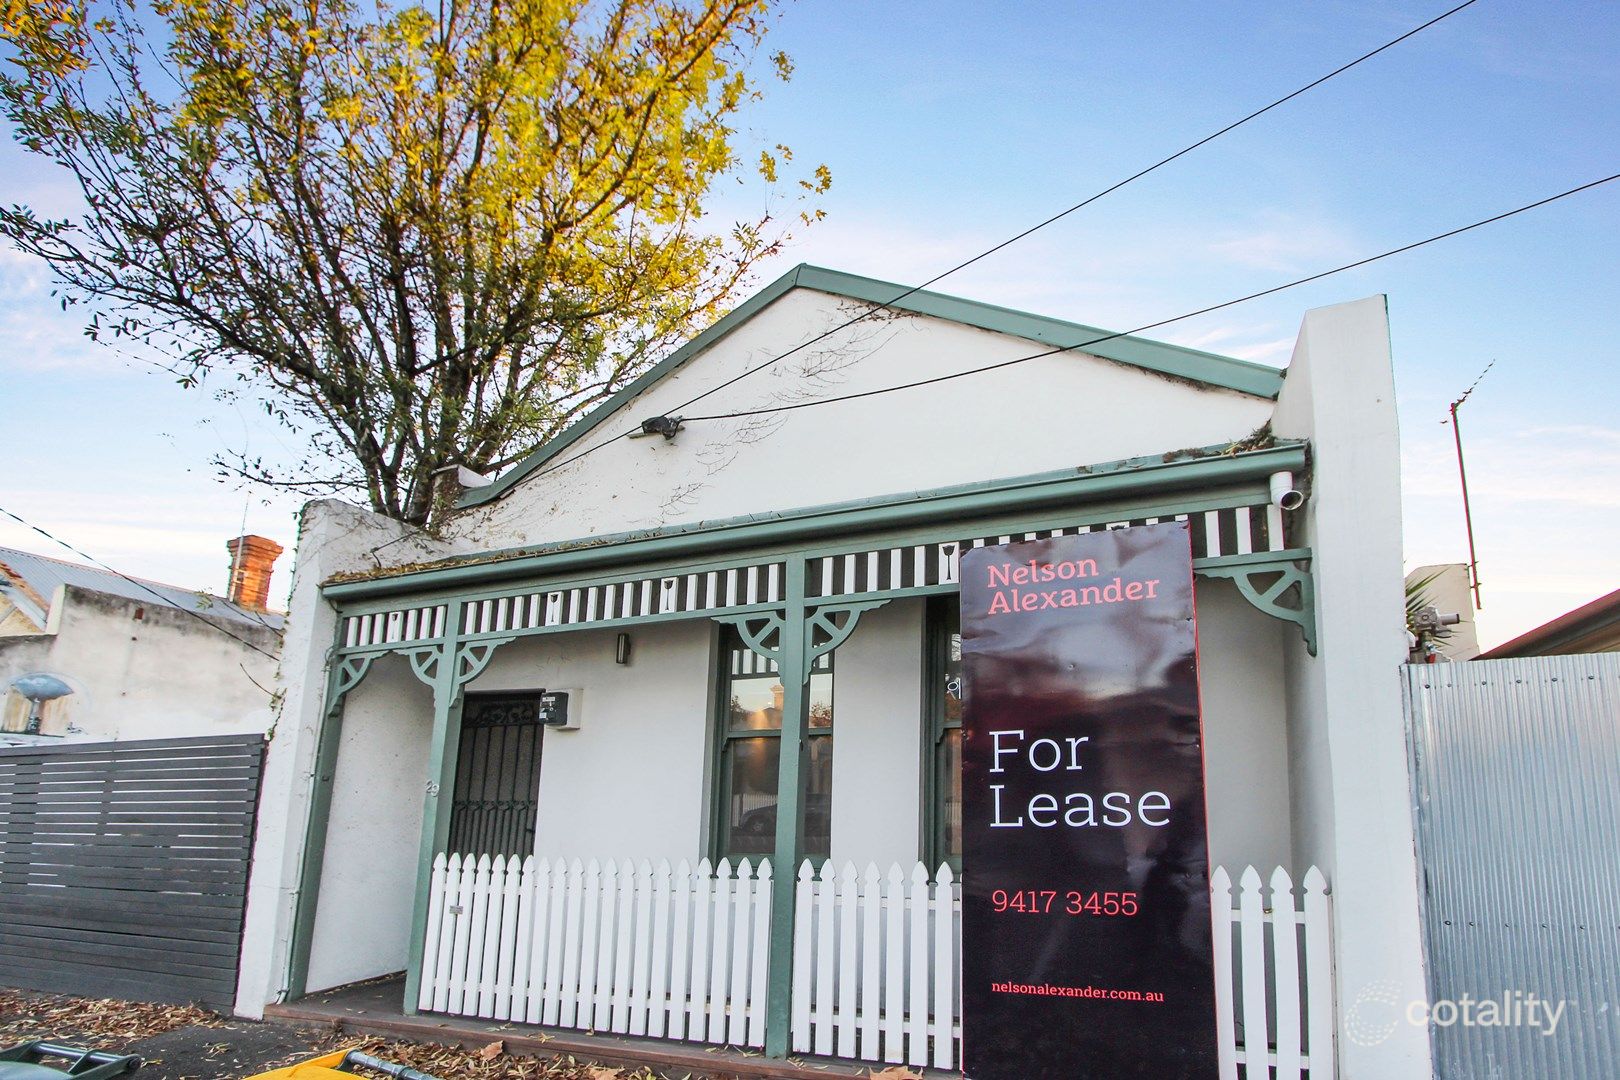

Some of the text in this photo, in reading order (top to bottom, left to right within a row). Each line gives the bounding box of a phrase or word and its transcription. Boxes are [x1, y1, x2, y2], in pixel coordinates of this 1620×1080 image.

[987, 558, 1098, 588] Nelson
[988, 577, 1160, 614] Alexander
[989, 730, 1089, 773] For
[989, 784, 1171, 828] Lease
[992, 889, 1138, 916] 9417 3455
[991, 981, 1164, 1002] nelsonalexander.com.au
